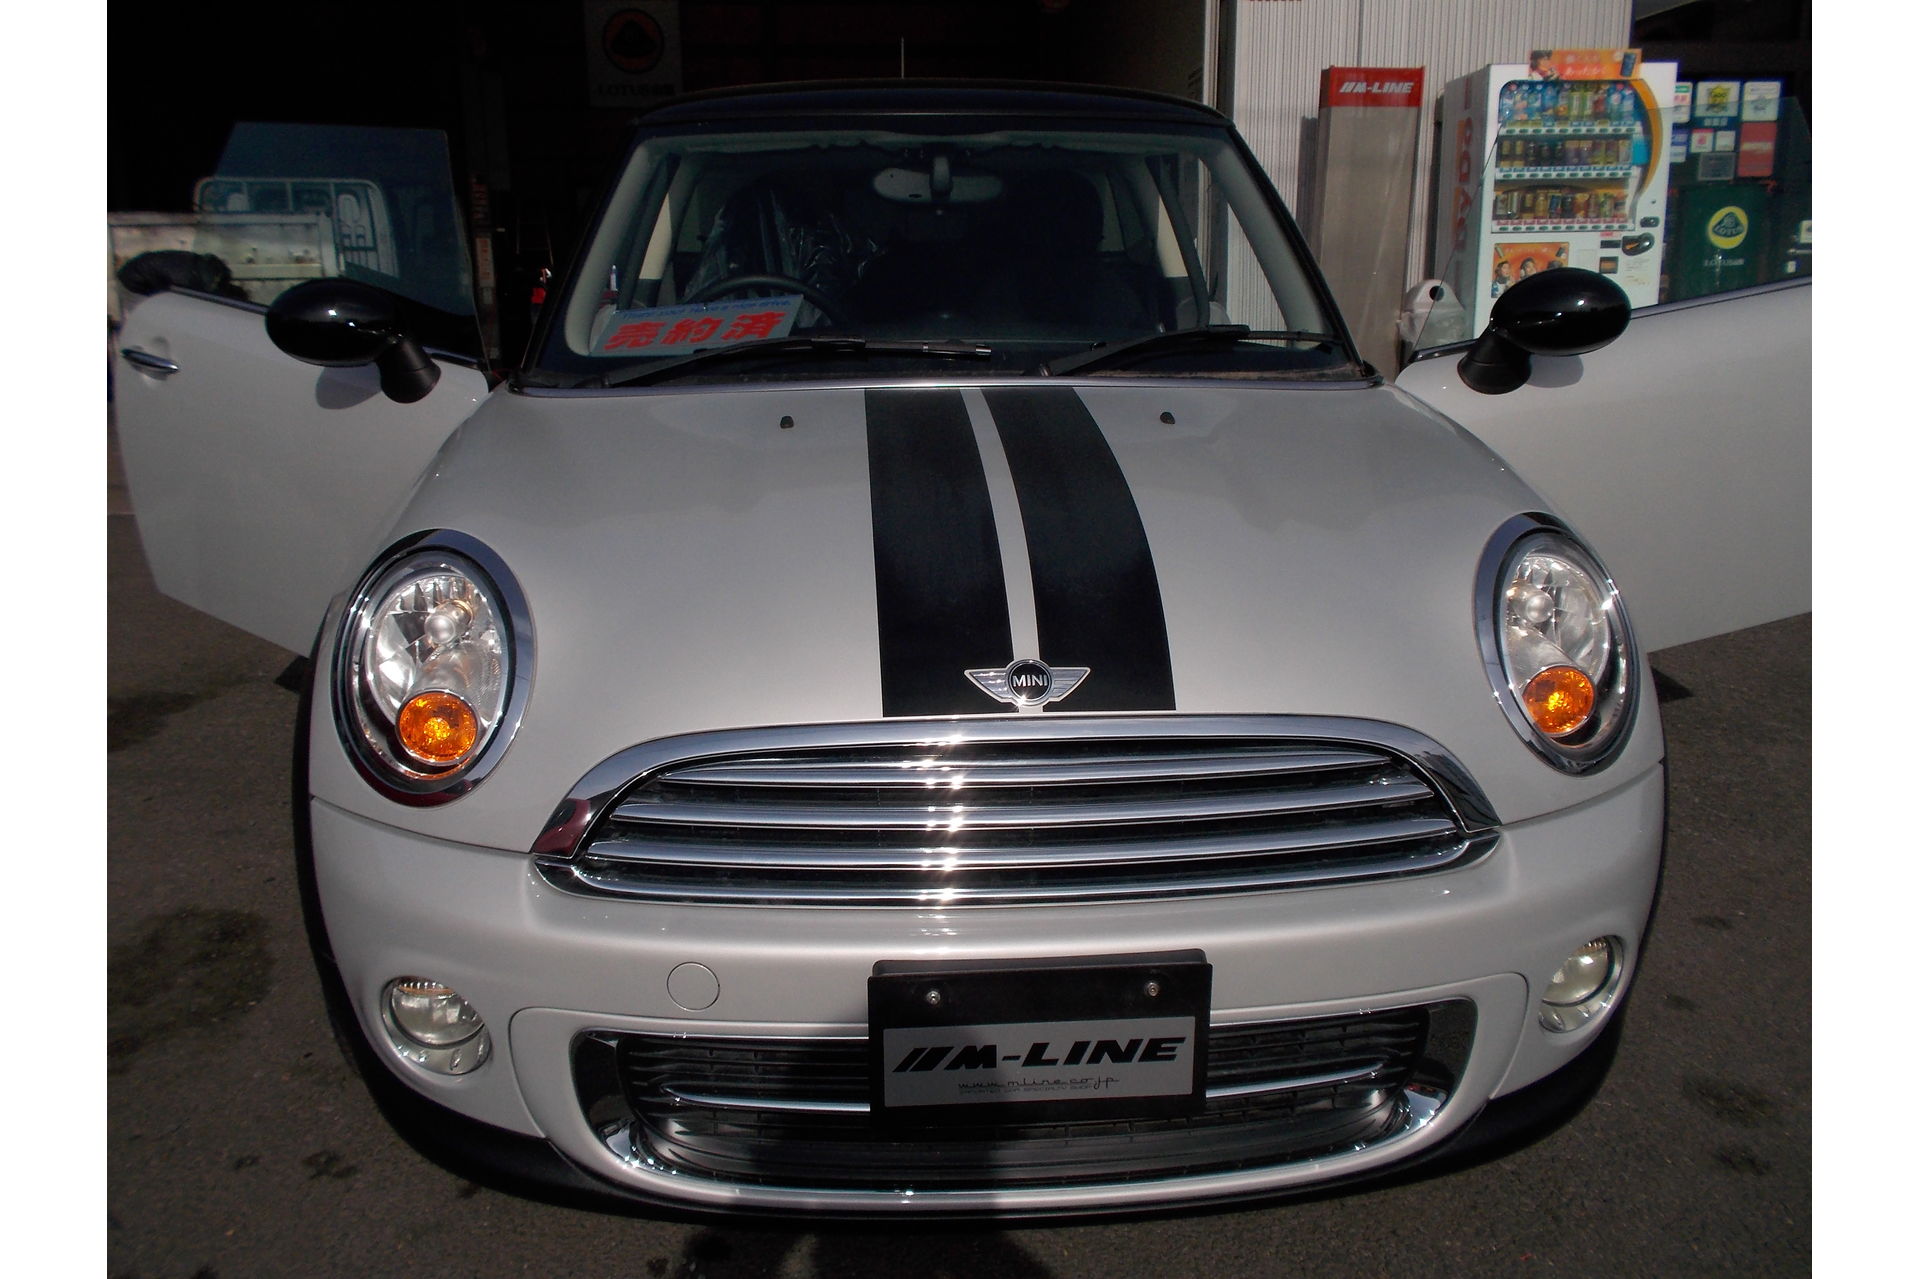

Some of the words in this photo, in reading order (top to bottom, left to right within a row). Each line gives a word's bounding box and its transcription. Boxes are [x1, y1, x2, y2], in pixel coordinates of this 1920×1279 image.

[604, 311, 788, 351] 売約済
[1012, 674, 1048, 688] MINI
